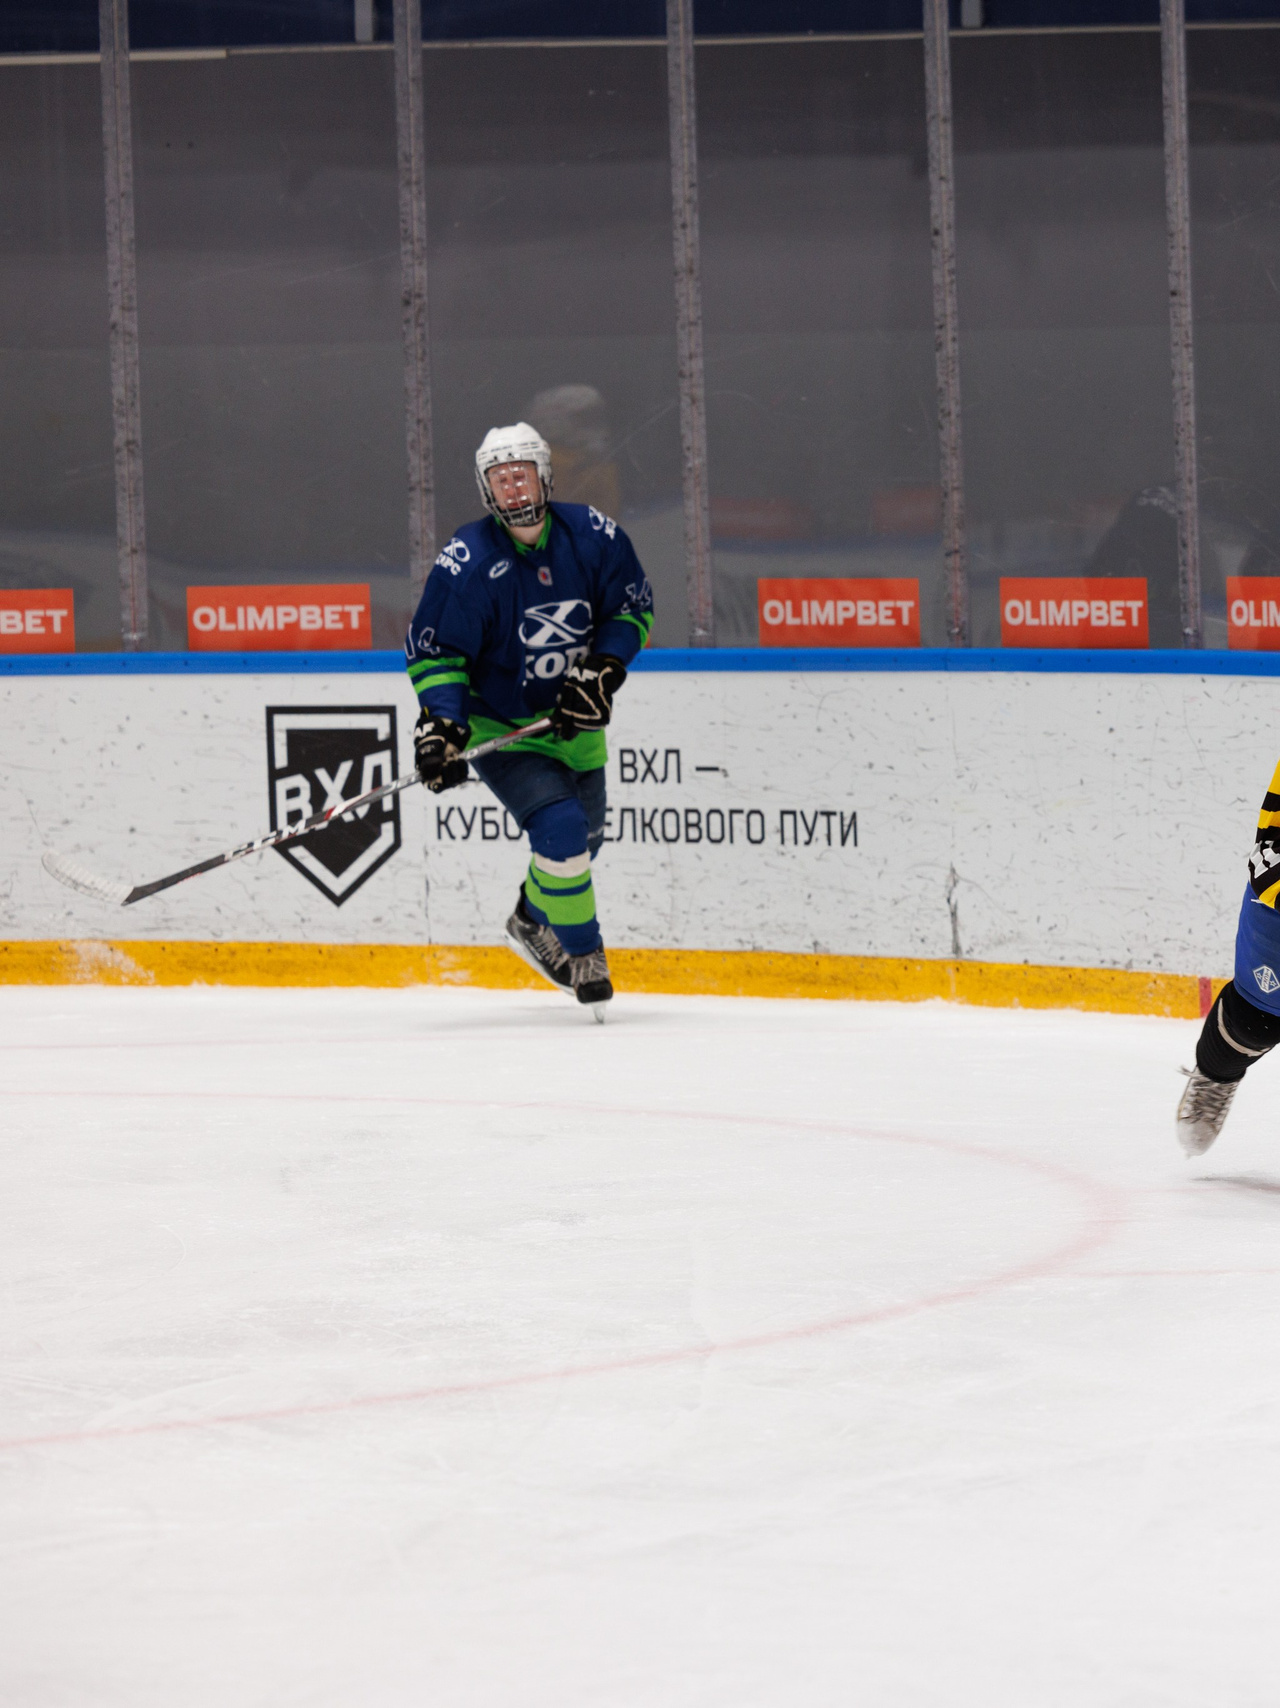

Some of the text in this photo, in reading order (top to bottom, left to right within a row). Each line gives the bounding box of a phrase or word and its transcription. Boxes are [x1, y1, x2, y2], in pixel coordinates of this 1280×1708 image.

[192, 604, 365, 632] OLIMPBET
[763, 599, 915, 627] OLIMPBET
[1004, 599, 1144, 627] OLIMPBET
[619, 748, 682, 784] ВХЛ
[275, 749, 394, 840] ВХЛ
[602, 807, 765, 844] ЕЛКОВОГО
[780, 809, 858, 847] ПУТИ
